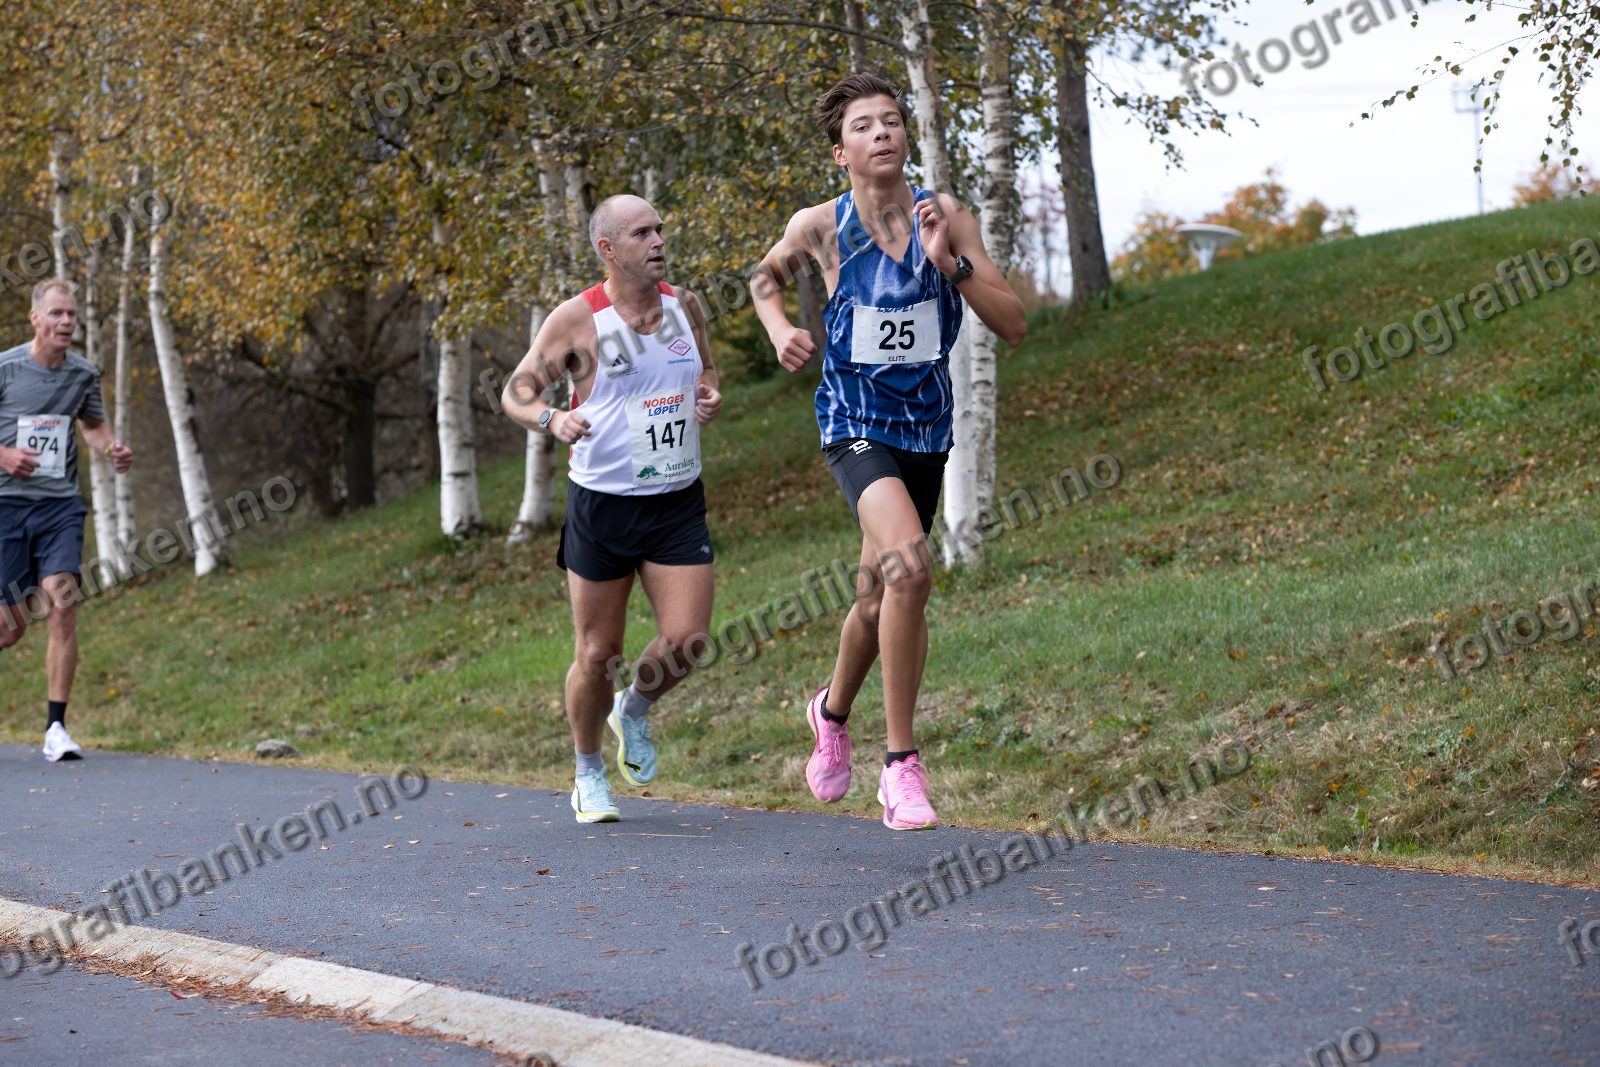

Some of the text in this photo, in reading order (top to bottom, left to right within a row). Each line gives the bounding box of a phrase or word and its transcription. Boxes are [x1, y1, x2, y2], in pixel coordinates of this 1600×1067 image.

[879, 320, 915, 350] 25
[642, 394, 684, 409] NORGES
[648, 404, 680, 417] LØPET
[646, 419, 686, 451] 147
[28, 436, 58, 455] 974
